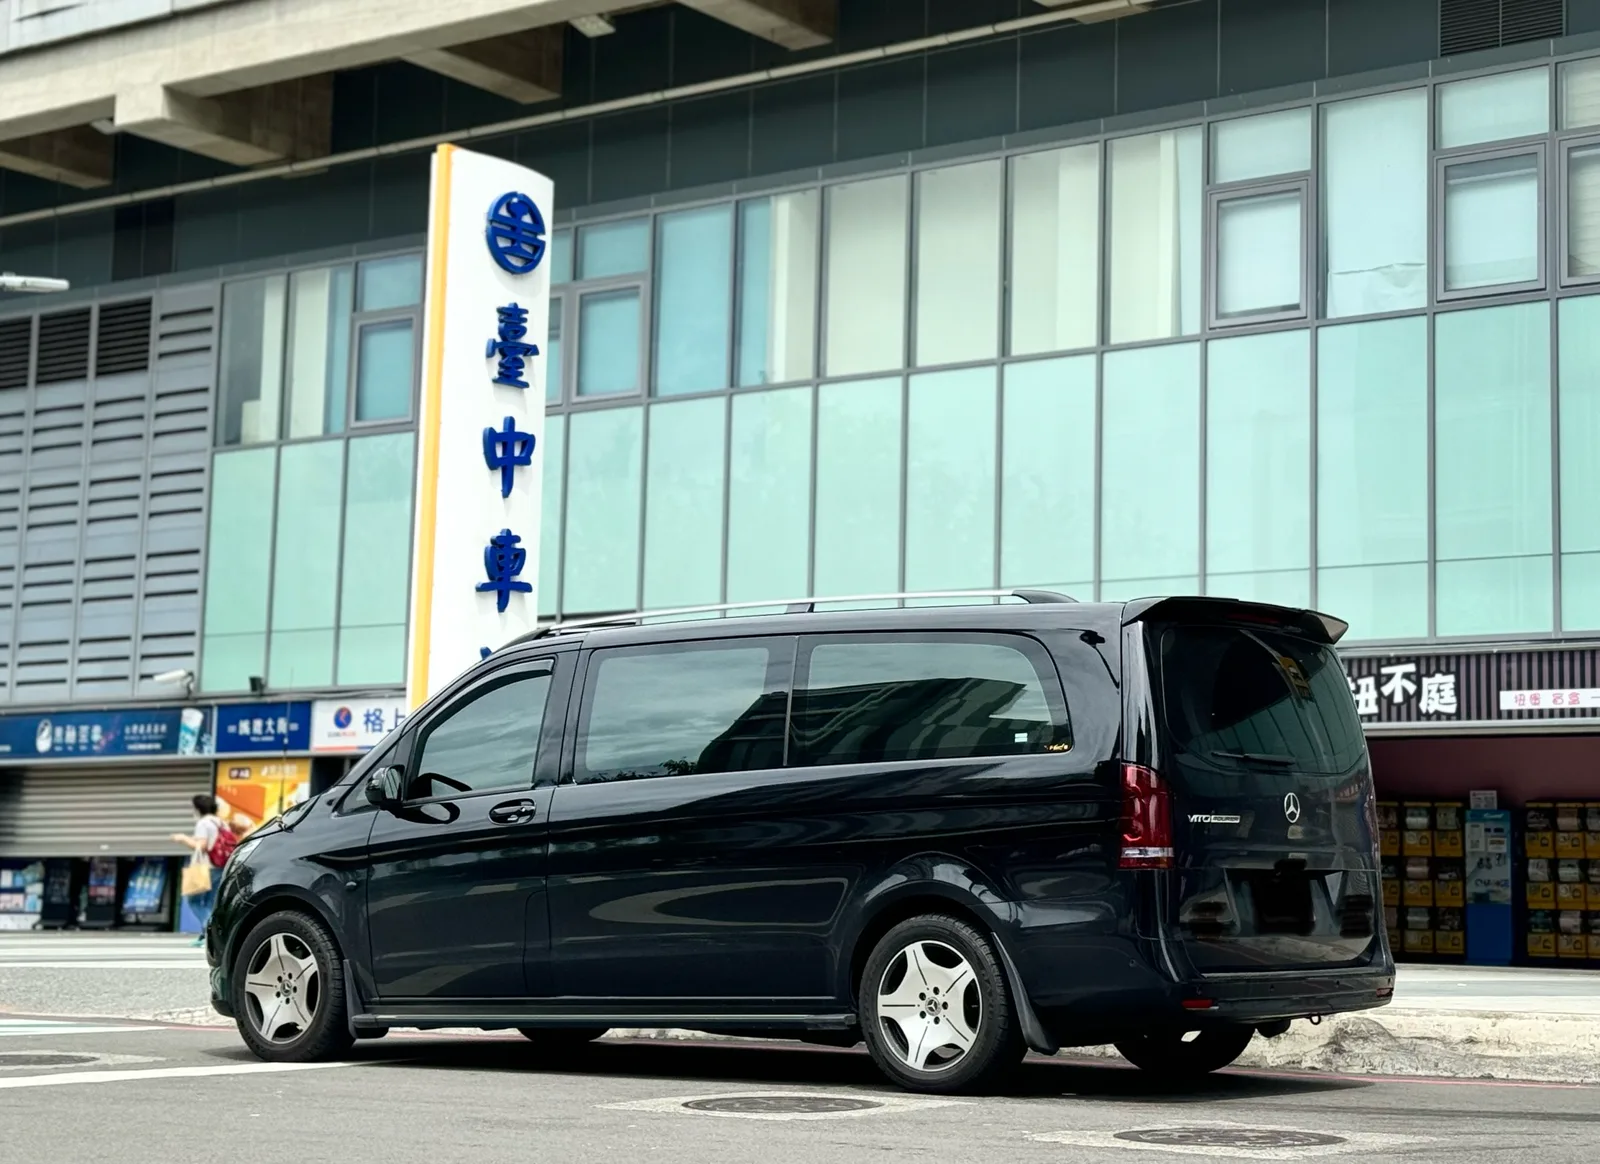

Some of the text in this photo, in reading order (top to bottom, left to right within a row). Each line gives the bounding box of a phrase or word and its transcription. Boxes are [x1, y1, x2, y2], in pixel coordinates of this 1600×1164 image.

[475, 302, 539, 661] 臺中車
[363, 708, 405, 733] 格上
[1187, 814, 1211, 823] VITO
